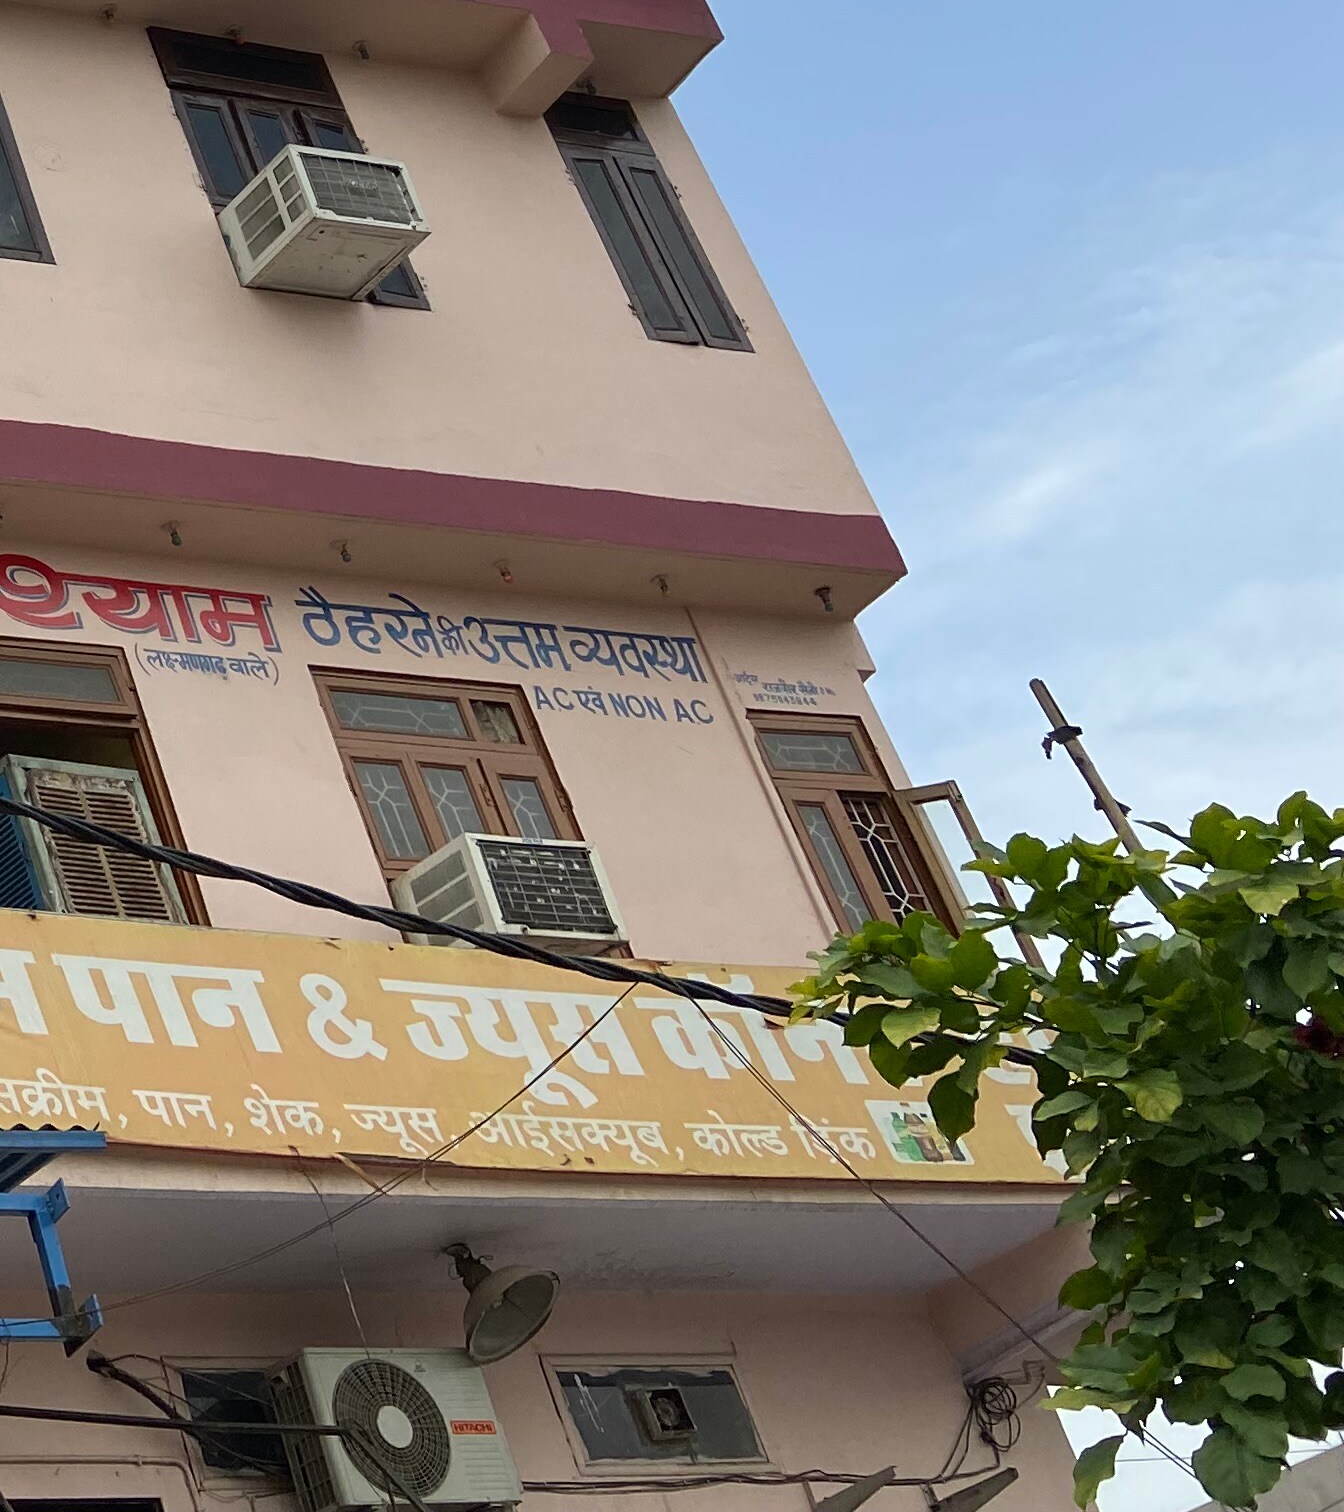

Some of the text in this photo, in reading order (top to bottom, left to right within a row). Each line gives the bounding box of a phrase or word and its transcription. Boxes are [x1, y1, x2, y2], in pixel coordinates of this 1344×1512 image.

[436, 615, 470, 656] की
[463, 616, 572, 672] उत्तम
[563, 626, 708, 683] व्यवस्था
[533, 685, 574, 711] AC
[608, 692, 667, 722] NON
[673, 698, 714, 725] AC
[52, 952, 283, 1054] पान
[297, 972, 388, 1062] &
[378, 978, 645, 1109] ज्यूस
[683, 1109, 789, 1158] कोल्ड
